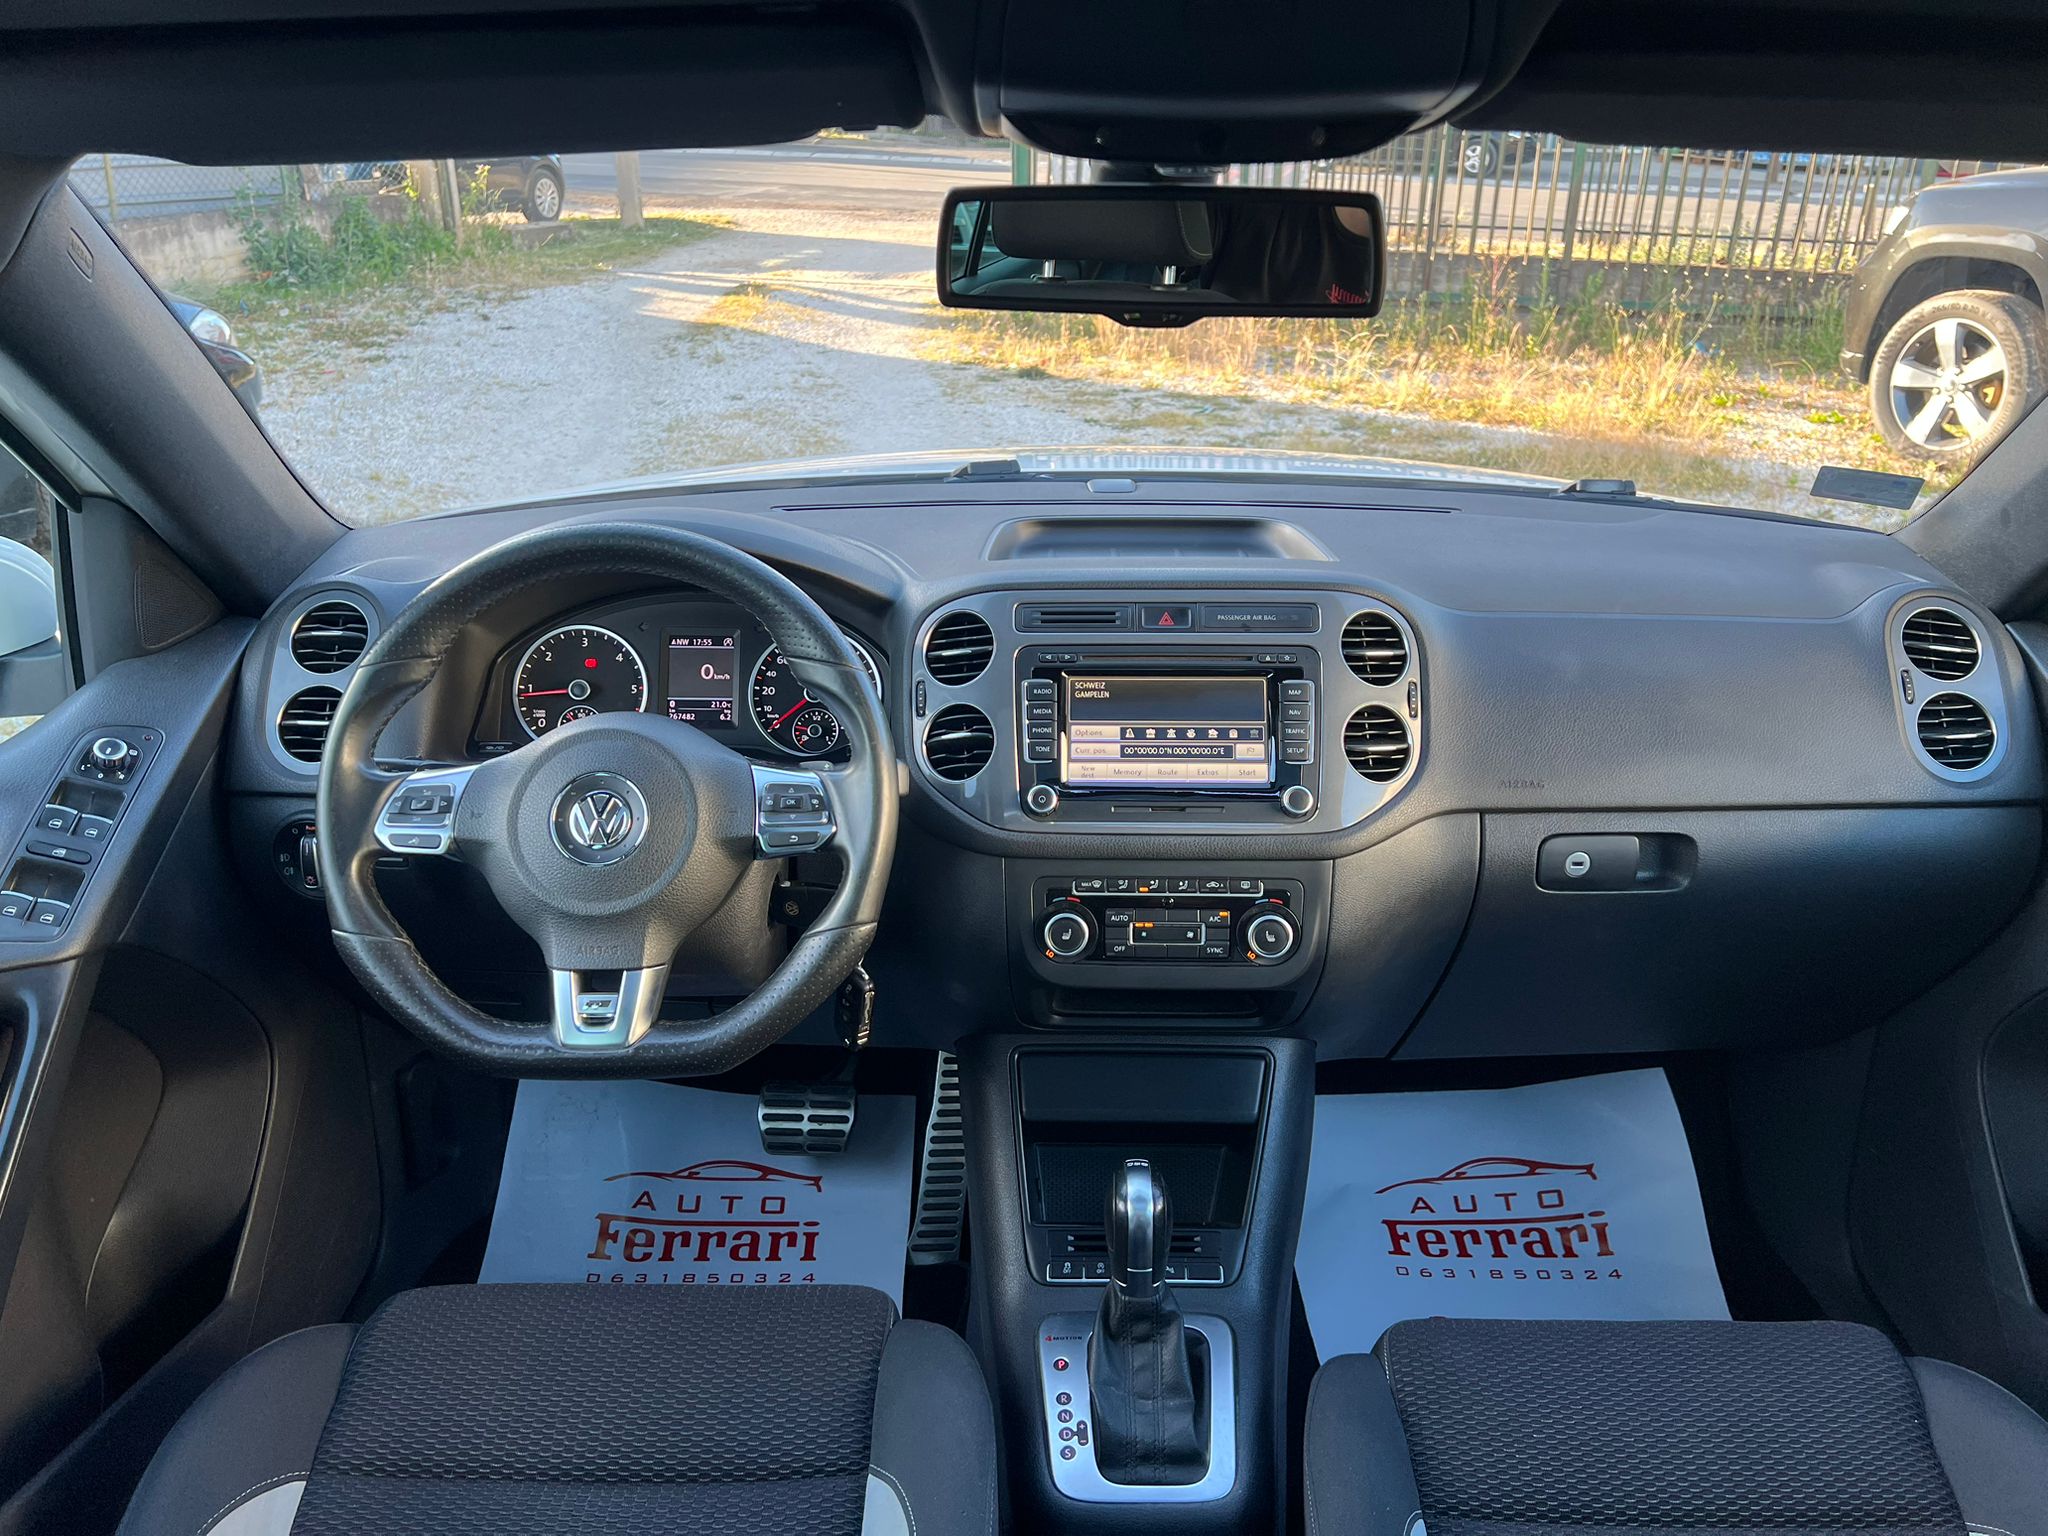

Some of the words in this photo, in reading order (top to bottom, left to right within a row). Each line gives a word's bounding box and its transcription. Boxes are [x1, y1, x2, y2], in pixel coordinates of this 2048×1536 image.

[581, 637, 588, 647] 3
[693, 638, 713, 646] 17:55
[545, 652, 552, 661] 2
[615, 653, 624, 662] 4
[700, 663, 714, 680] 0
[527, 684, 533, 693] 1
[631, 684, 638, 693] 5
[1074, 681, 1106, 690] SCHWEIZ
[762, 686, 776, 696] 20
[1074, 690, 1110, 699] GAMPELEN
[669, 700, 676, 708] 0
[719, 713, 732, 721] 6.2
[538, 718, 546, 728] 0
[1074, 729, 1103, 738] Options
[1113, 769, 1142, 777] Memory
[1157, 768, 1178, 776] Route
[1197, 768, 1219, 776] Extras
[1045, 949, 1055, 958] LO
[1247, 950, 1256, 960] LO
[631, 1190, 786, 1214] AUTO
[1410, 1189, 1565, 1214] AUTO
[587, 1212, 820, 1262] Ferrari
[1380, 1210, 1615, 1258] Ferrari
[1395, 1266, 1623, 1280] 0631850324
[586, 1272, 815, 1284] 0631850324
[1058, 1360, 1065, 1369] P
[1060, 1394, 1068, 1403] R
[1061, 1412, 1070, 1421] N
[1063, 1430, 1072, 1439] D
[1064, 1448, 1072, 1458] S
